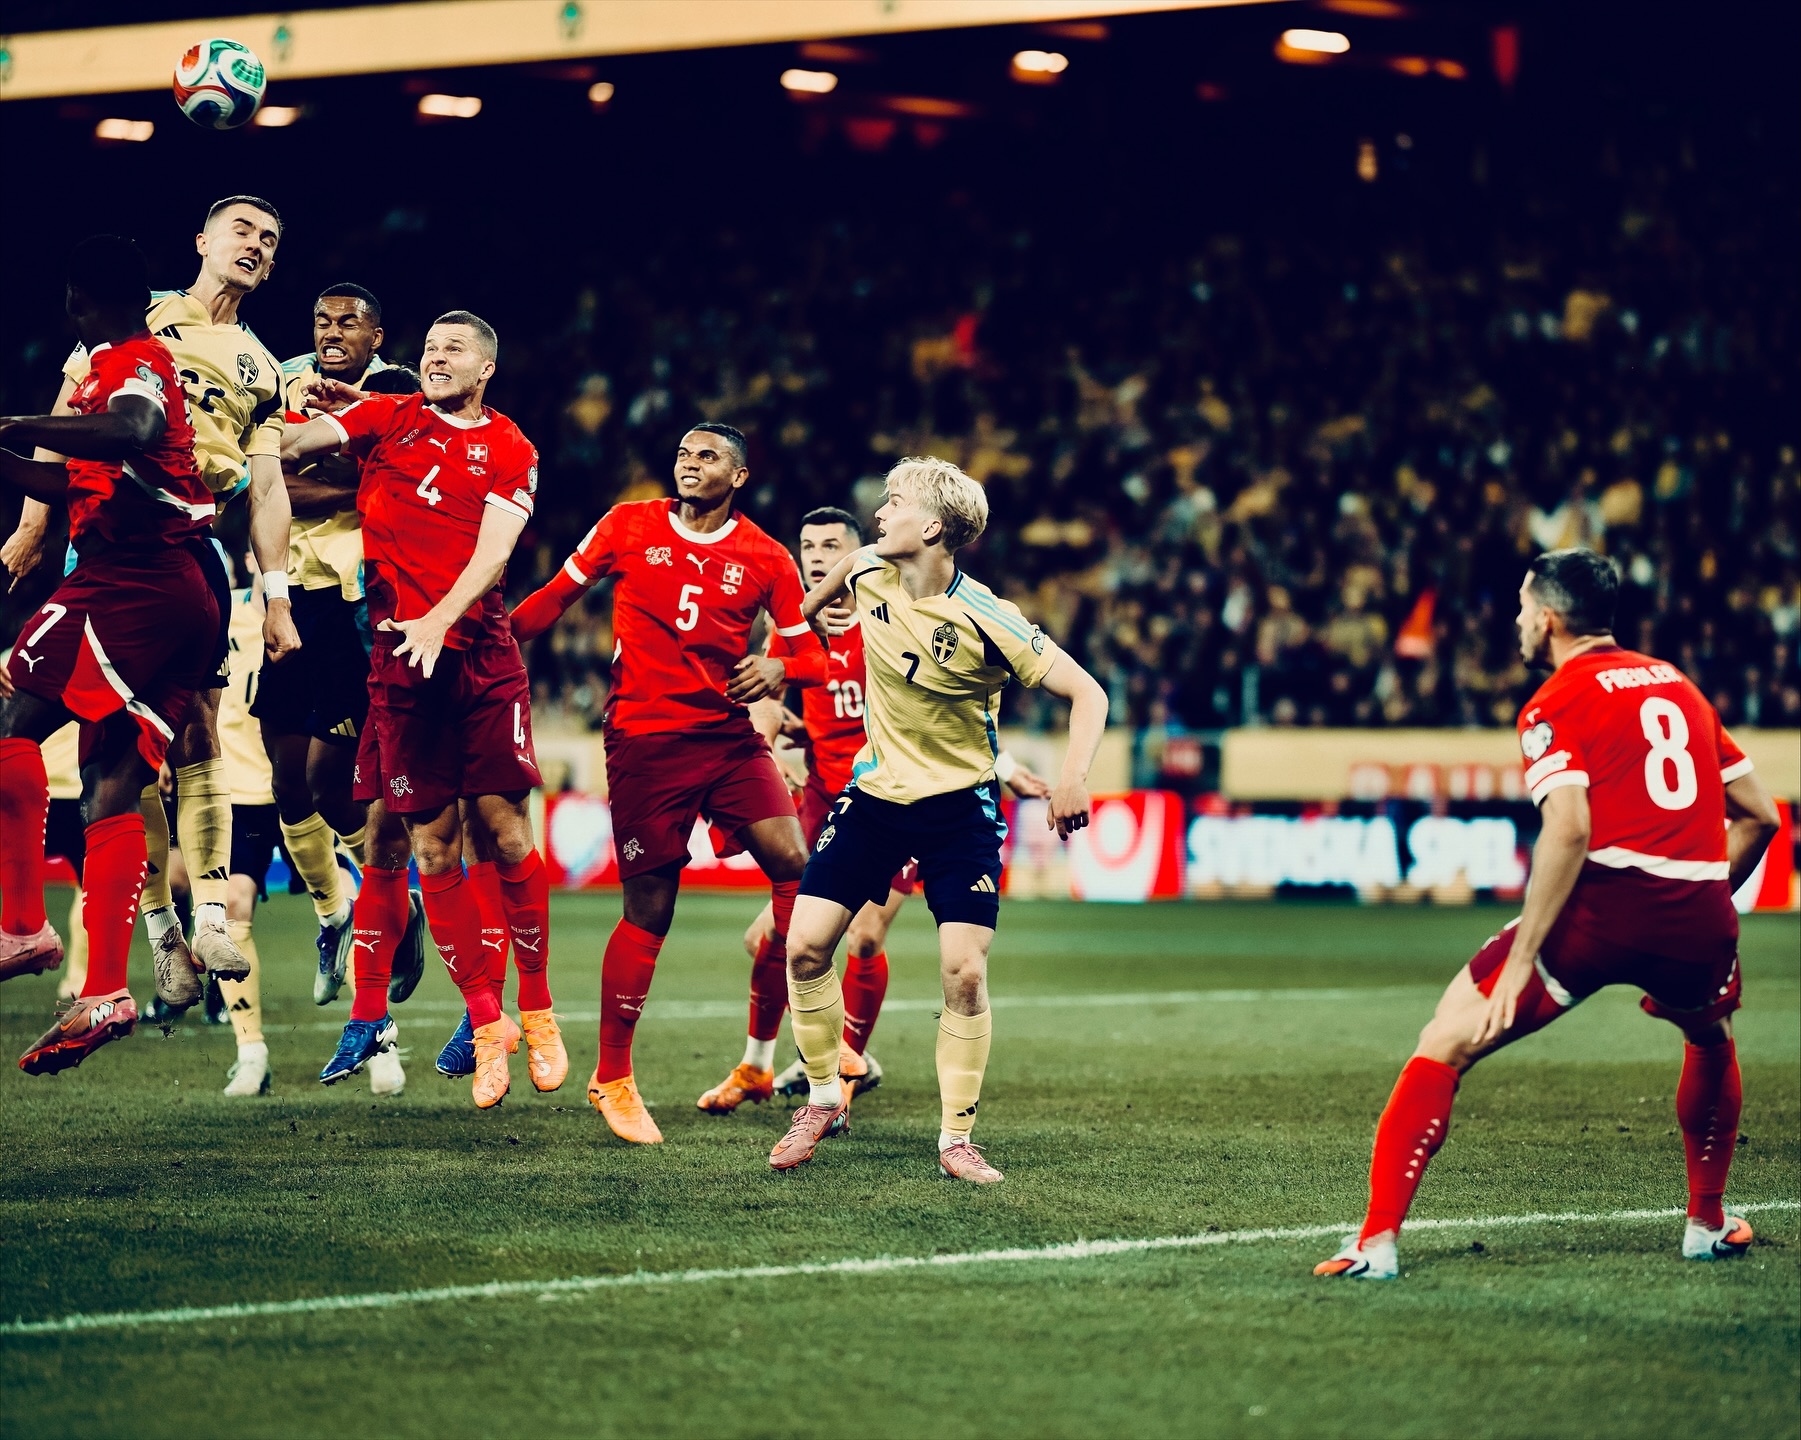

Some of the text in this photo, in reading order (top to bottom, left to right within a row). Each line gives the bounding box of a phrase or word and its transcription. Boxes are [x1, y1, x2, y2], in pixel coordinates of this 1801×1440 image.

[416, 465, 442, 506] 4
[26, 602, 67, 648] 7
[675, 584, 704, 631] 5
[901, 651, 921, 686] 7
[826, 678, 864, 719] 10
[513, 702, 526, 750] 4
[1639, 696, 1698, 811] 8
